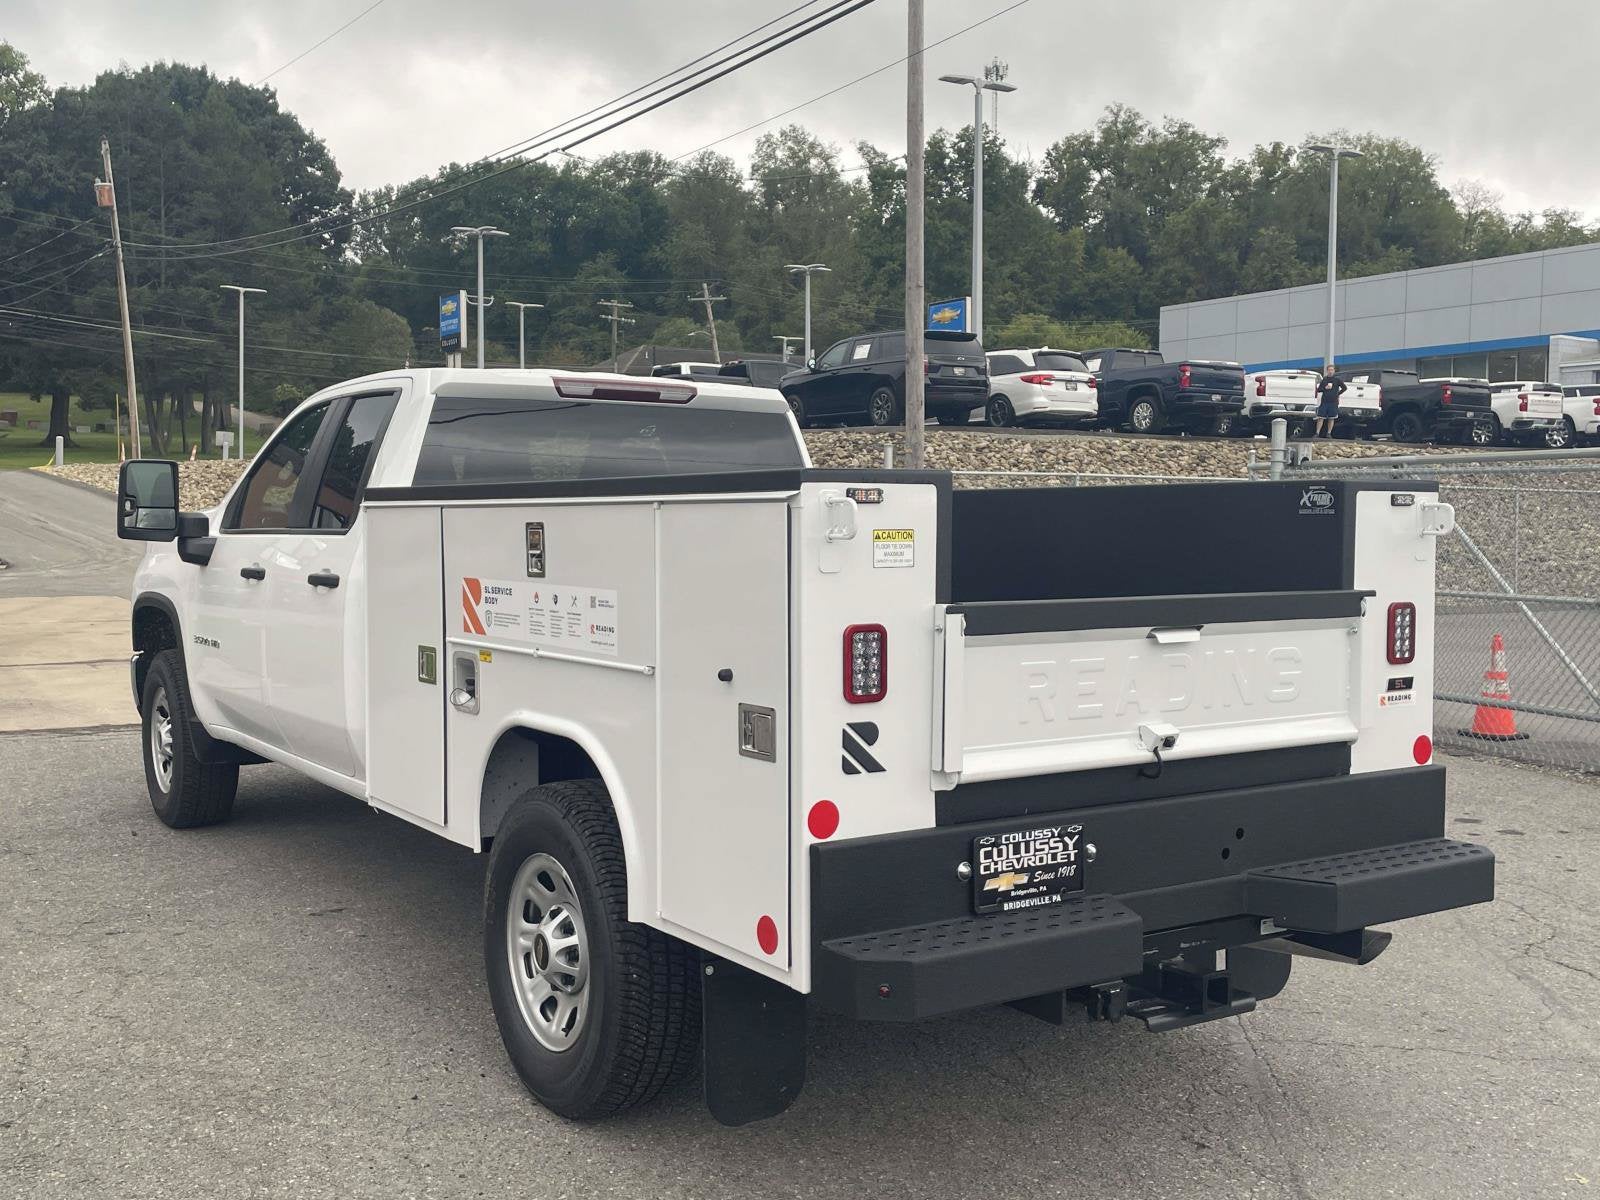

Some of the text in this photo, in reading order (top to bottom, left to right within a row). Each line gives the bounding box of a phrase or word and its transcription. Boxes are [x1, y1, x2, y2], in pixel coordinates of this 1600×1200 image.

[881, 531, 913, 540] CAUTION
[491, 586, 513, 596] SERVICE
[484, 596, 498, 605] BODY
[1019, 647, 1304, 724] READING
[1395, 679, 1406, 689] SL
[1387, 694, 1412, 702] READING
[1002, 828, 1061, 844] COLUSSY
[980, 835, 1080, 864] COLUSSY
[980, 850, 1079, 875] CHEVROLET
[1033, 865, 1077, 882] Since 1918
[1052, 894, 1062, 903] PA
